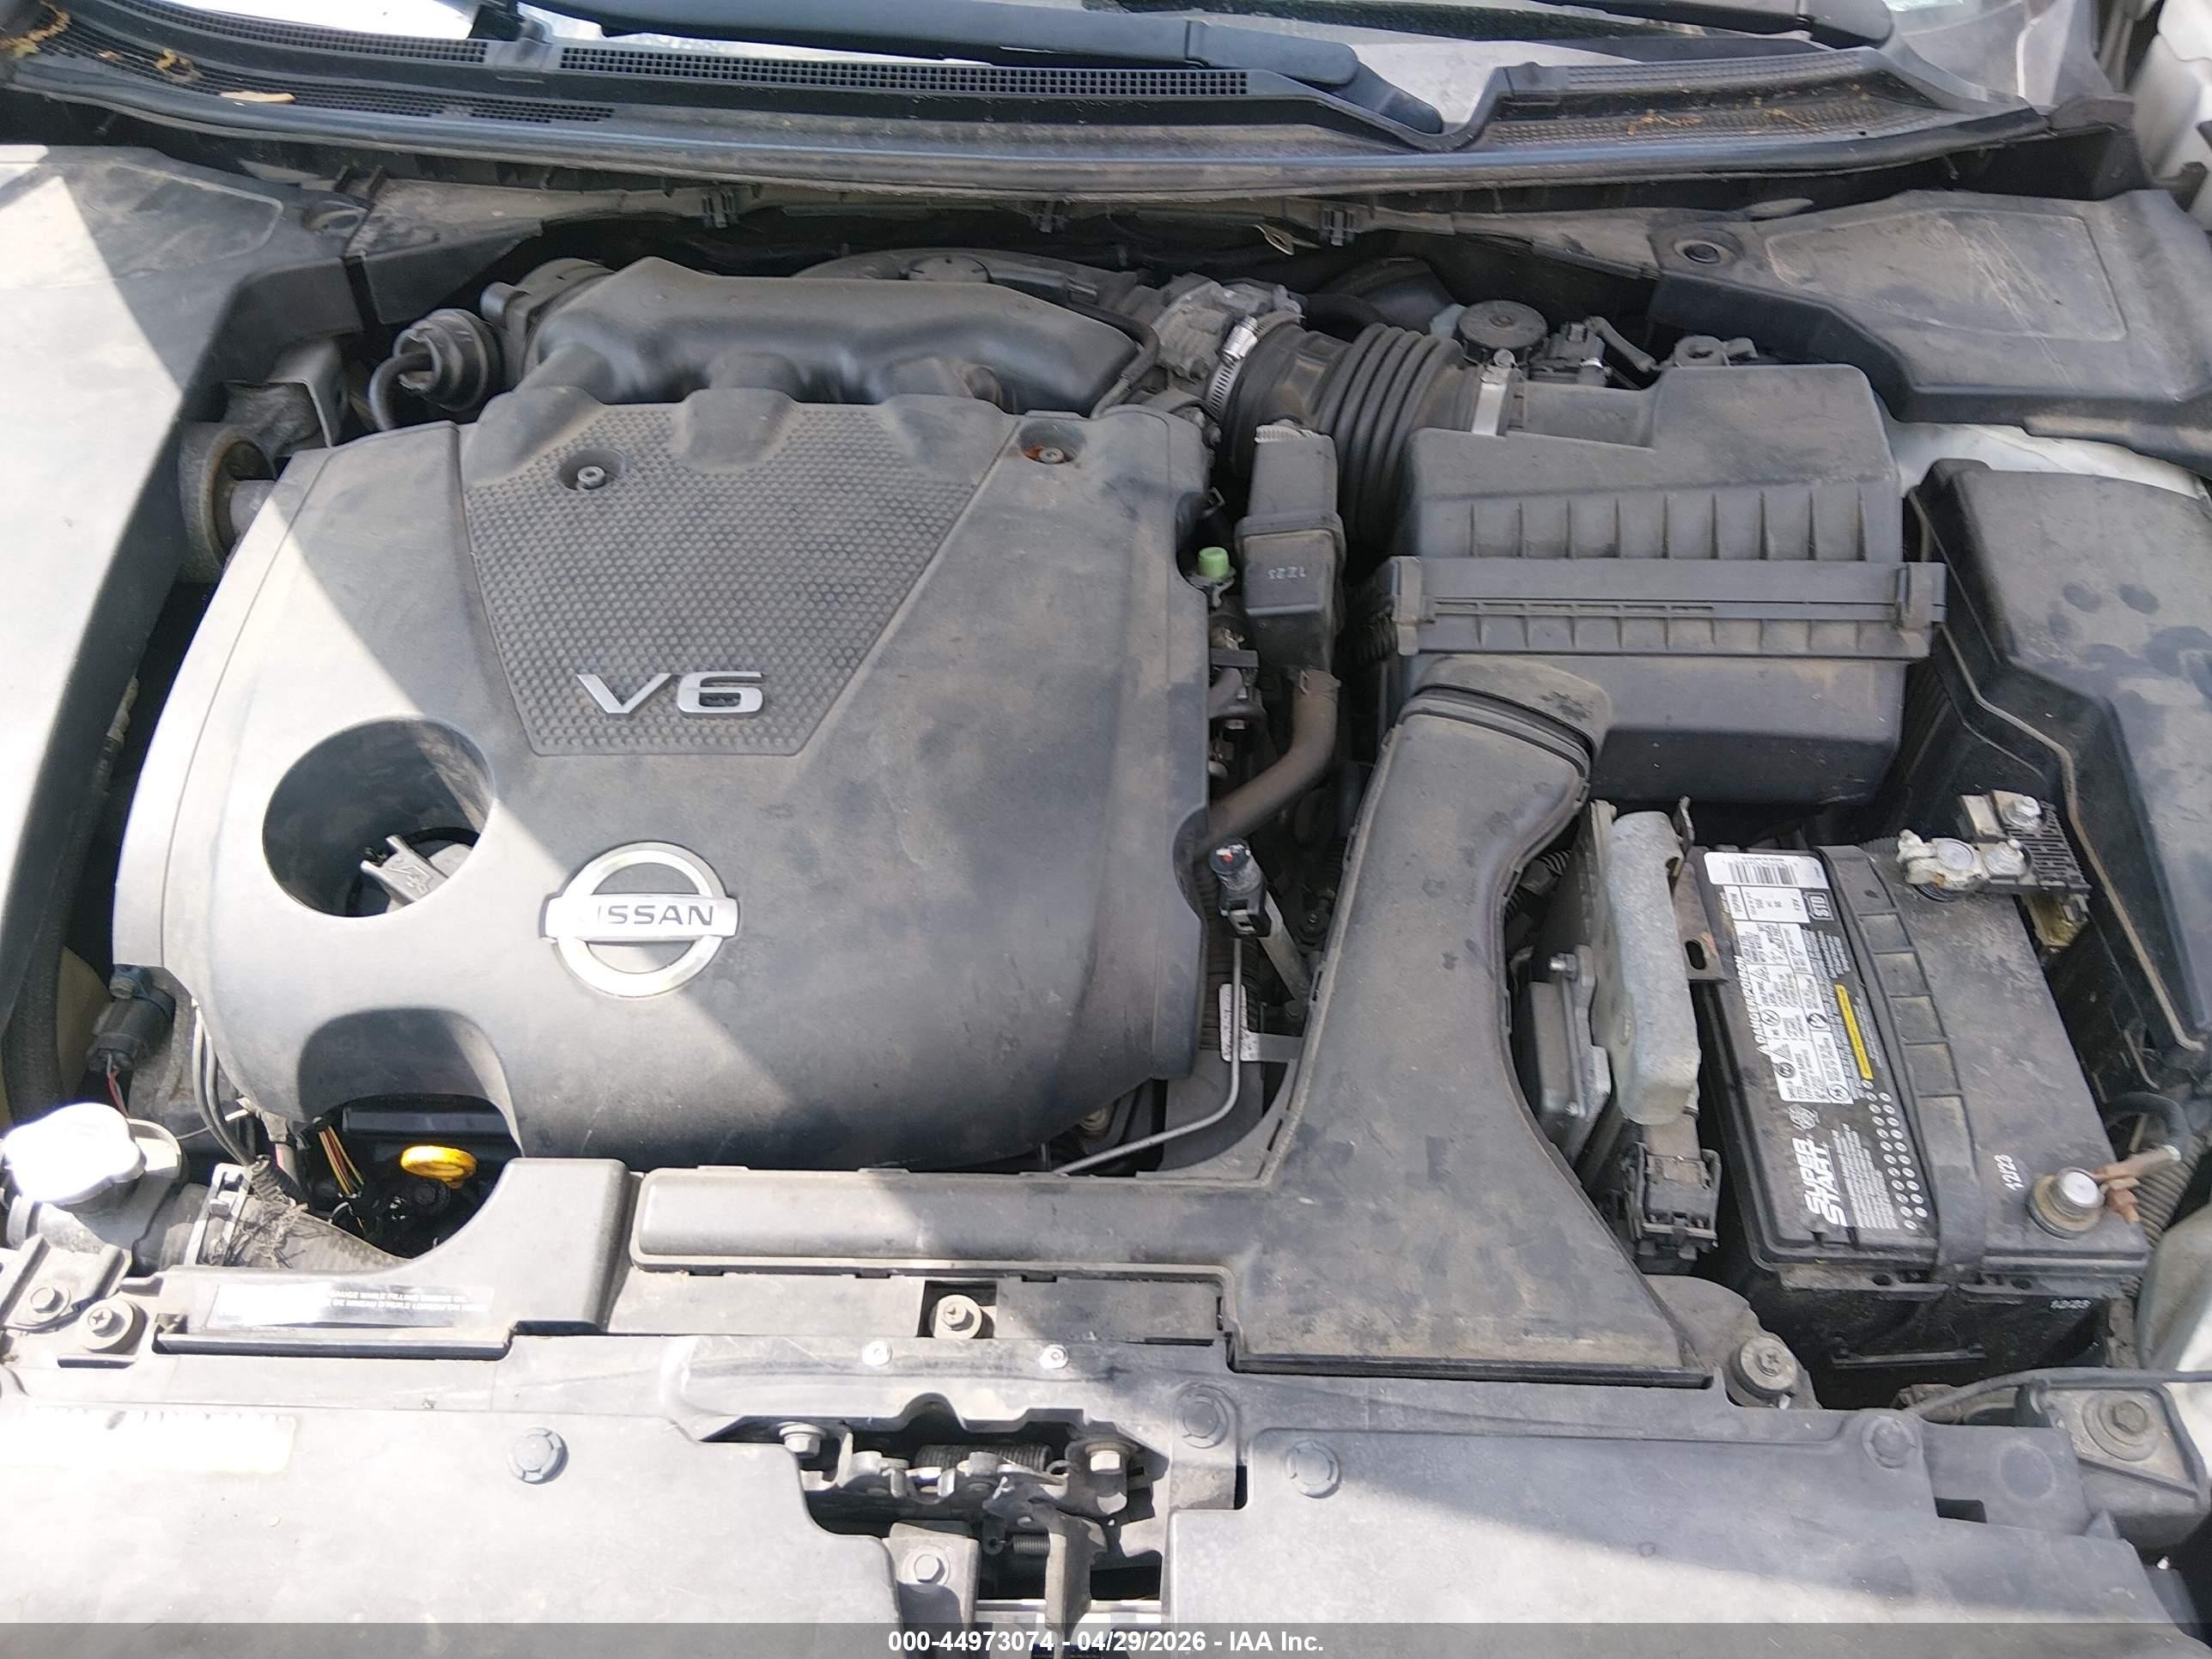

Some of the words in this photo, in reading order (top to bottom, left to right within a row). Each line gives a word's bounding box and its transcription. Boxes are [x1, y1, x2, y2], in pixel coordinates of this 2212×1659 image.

[576, 670, 763, 714] V6
[579, 904, 714, 927] ISSAN
[1792, 1138, 1821, 1214] SUPER
[1806, 1141, 1848, 1227] START
